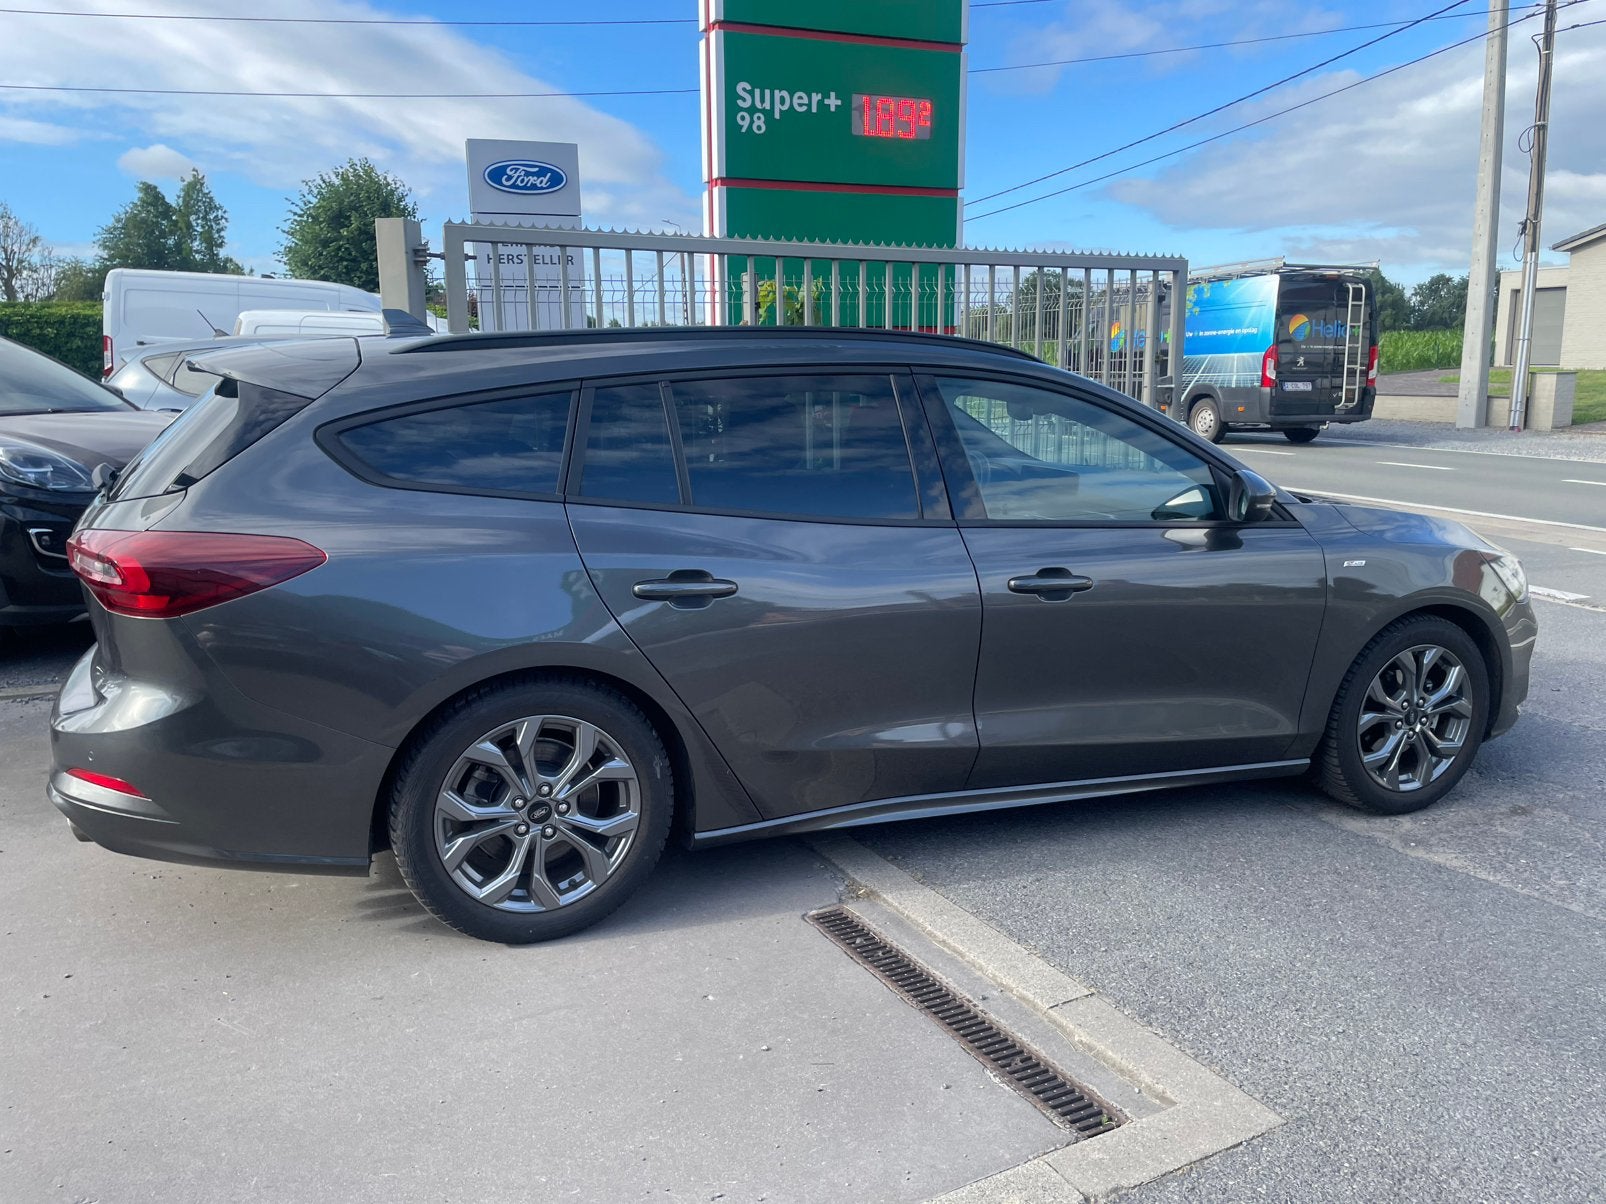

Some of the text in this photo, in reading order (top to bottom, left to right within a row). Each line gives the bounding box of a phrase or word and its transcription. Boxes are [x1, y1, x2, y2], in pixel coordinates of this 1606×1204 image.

[736, 81, 842, 119] Super+
[736, 111, 766, 134] 98
[501, 165, 552, 188] Ford
